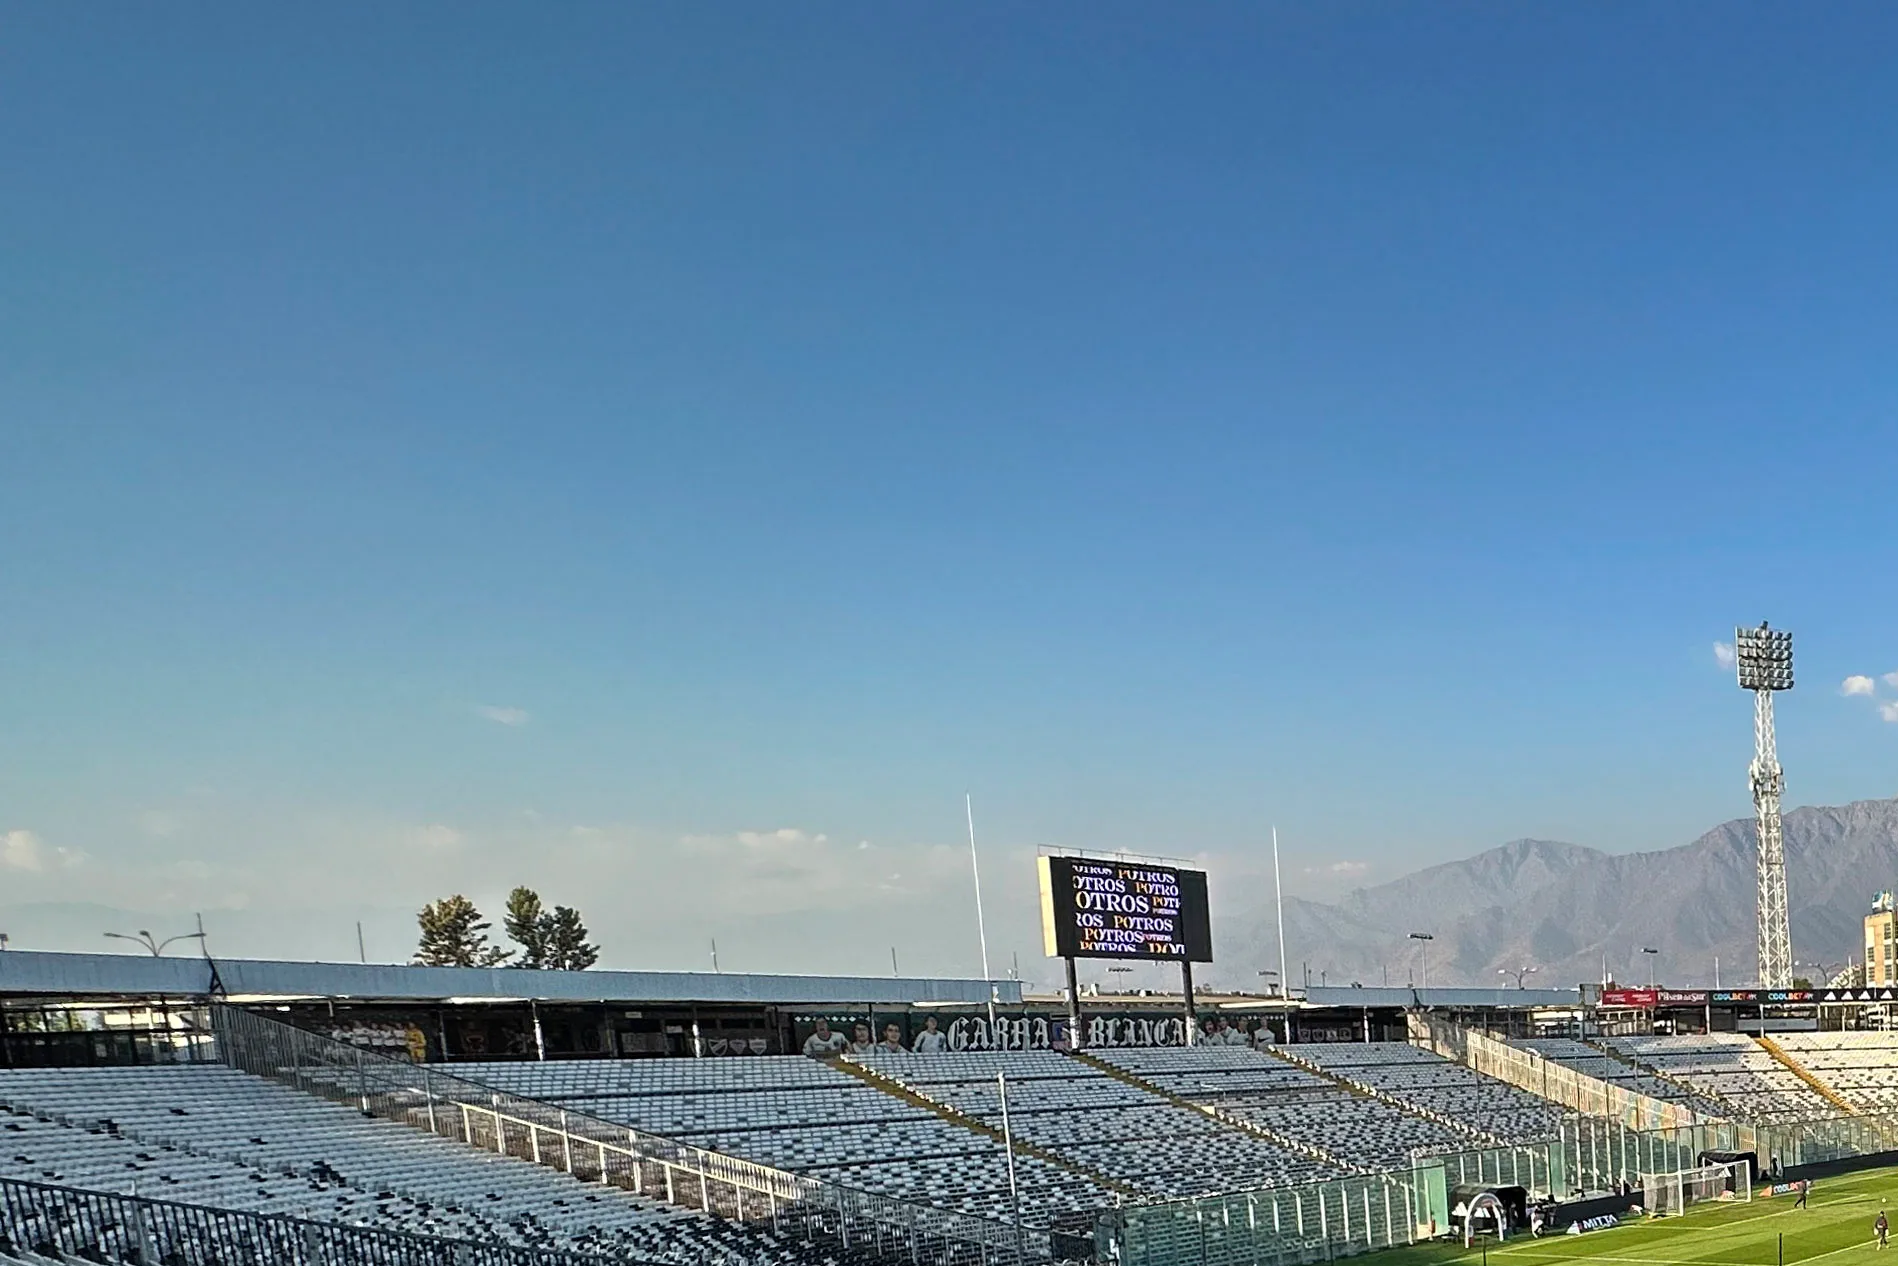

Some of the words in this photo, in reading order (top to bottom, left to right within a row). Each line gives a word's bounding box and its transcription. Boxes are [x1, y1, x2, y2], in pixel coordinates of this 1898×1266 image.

[1114, 915, 1174, 931] POTROS
[1084, 928, 1143, 943] POTROS
[1087, 1016, 1185, 1048] BLANCA
[1583, 1213, 1618, 1230] MITTA
